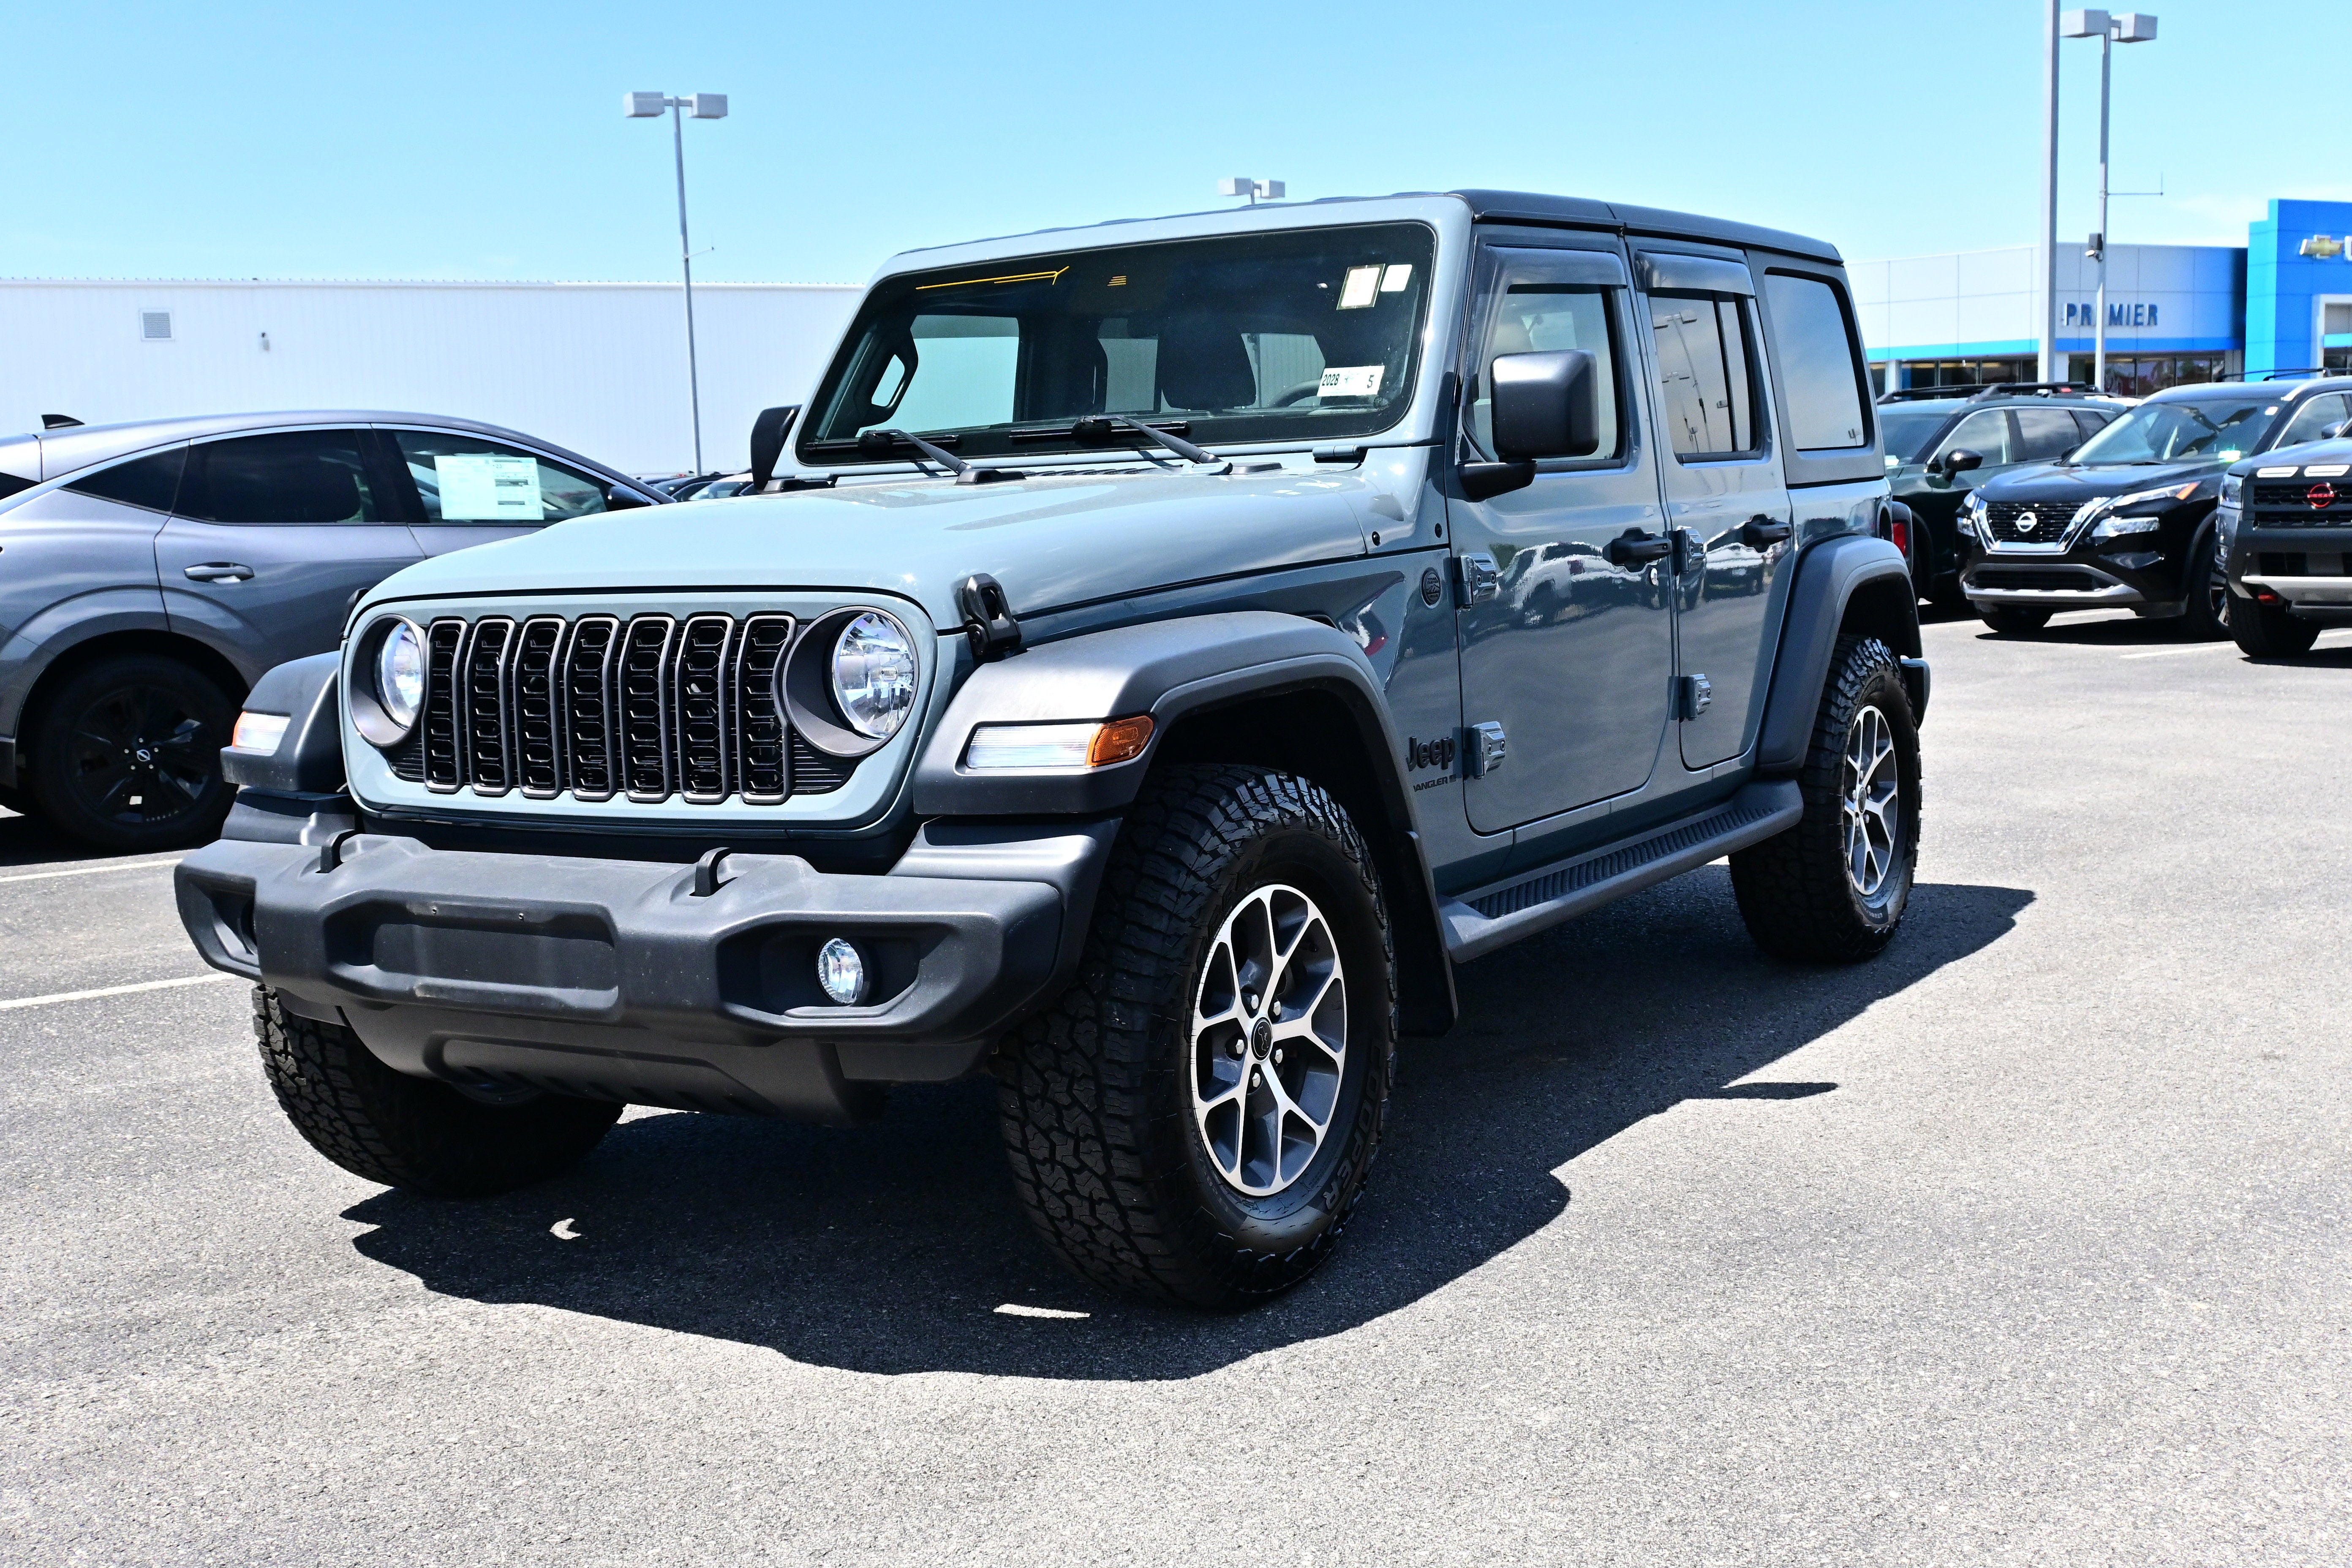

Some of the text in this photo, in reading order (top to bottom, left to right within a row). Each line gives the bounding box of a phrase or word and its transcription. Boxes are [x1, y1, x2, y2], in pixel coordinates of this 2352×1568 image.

[2063, 303, 2158, 326] PRMIER
[1322, 373, 1340, 386] 2028
[1405, 736, 1455, 772] Jeep
[1413, 776, 1448, 792] ANGLER
